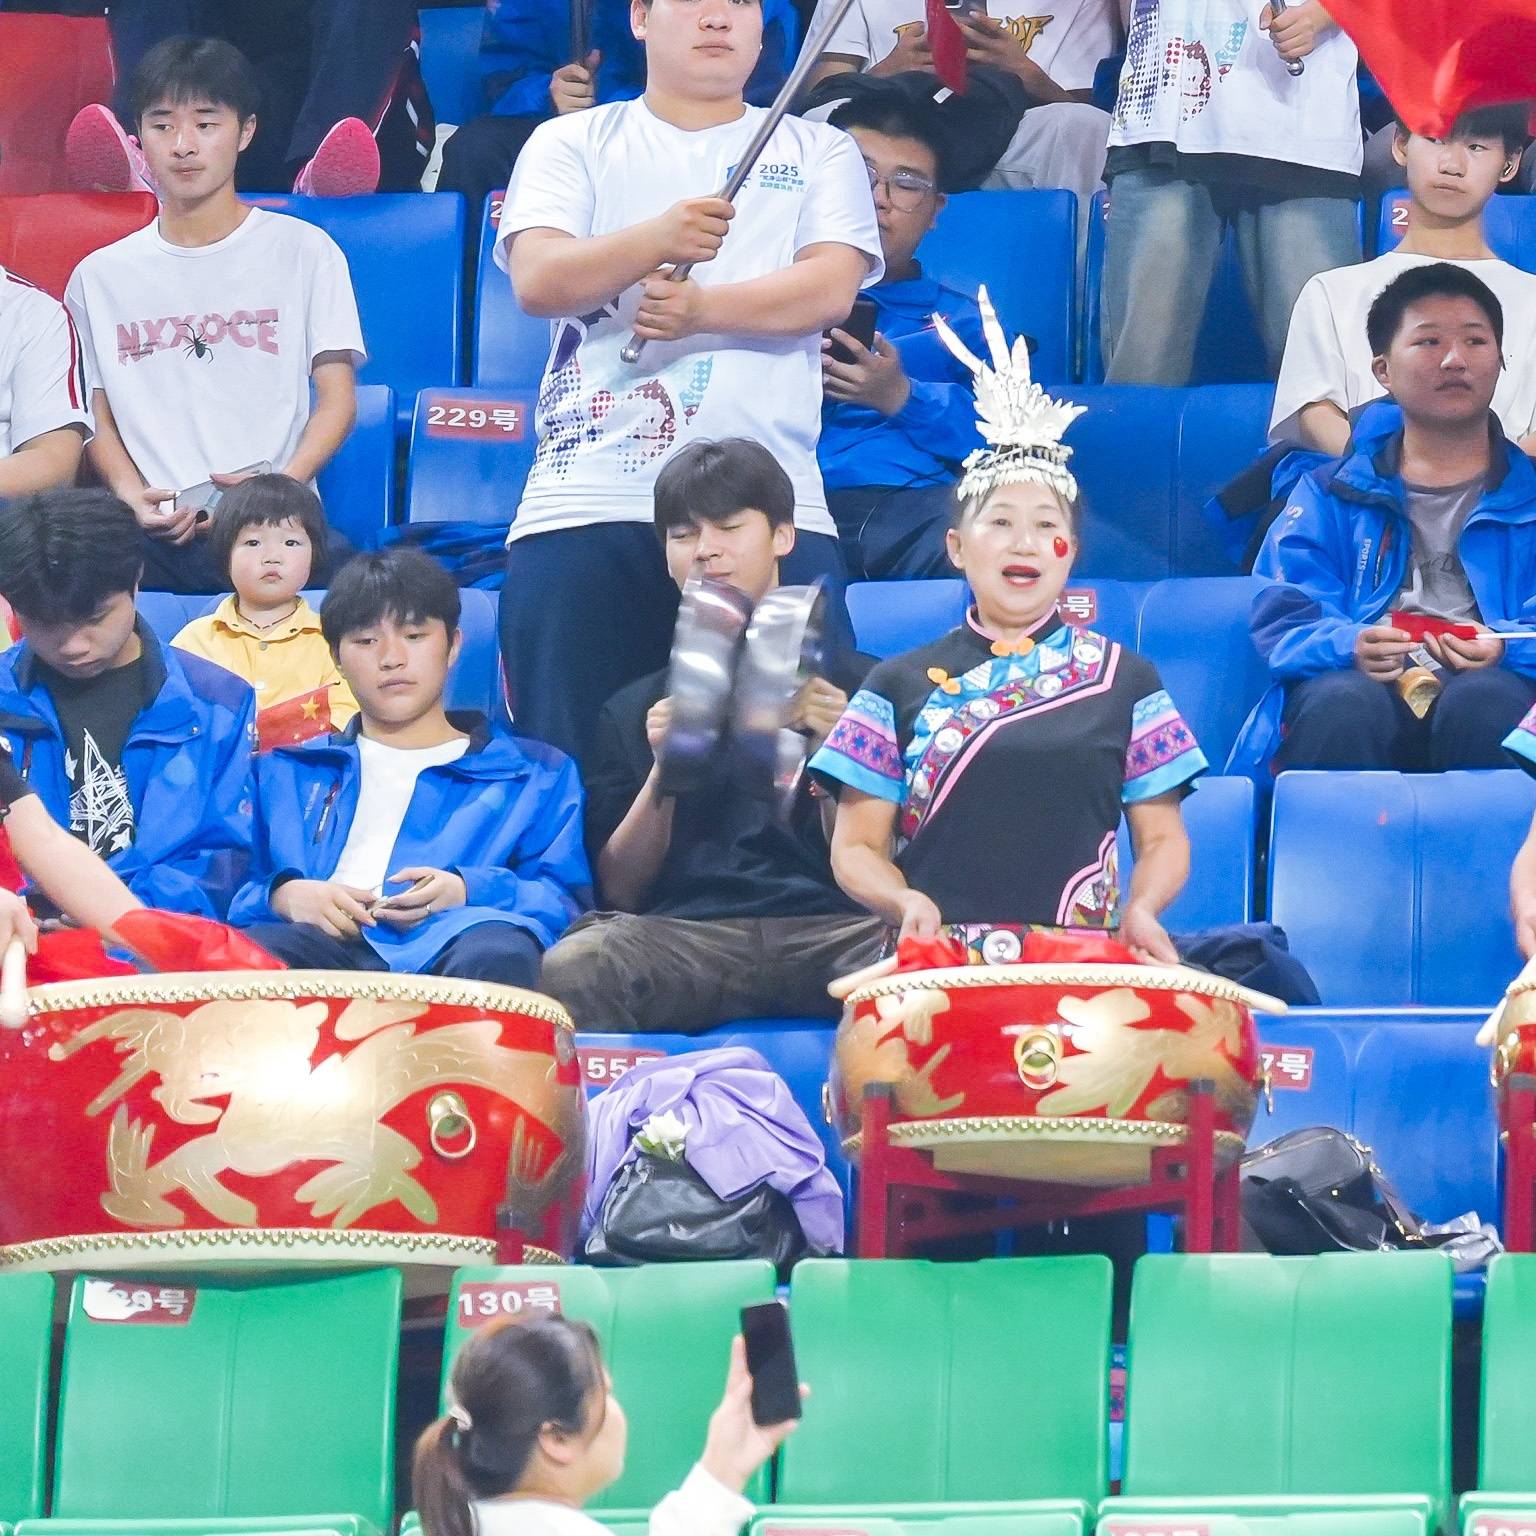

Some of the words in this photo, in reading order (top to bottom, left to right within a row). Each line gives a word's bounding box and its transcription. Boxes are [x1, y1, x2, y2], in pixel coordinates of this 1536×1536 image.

[759, 164, 799, 178] 2025
[427, 406, 519, 432] 229号
[459, 1286, 559, 1317] 130号
